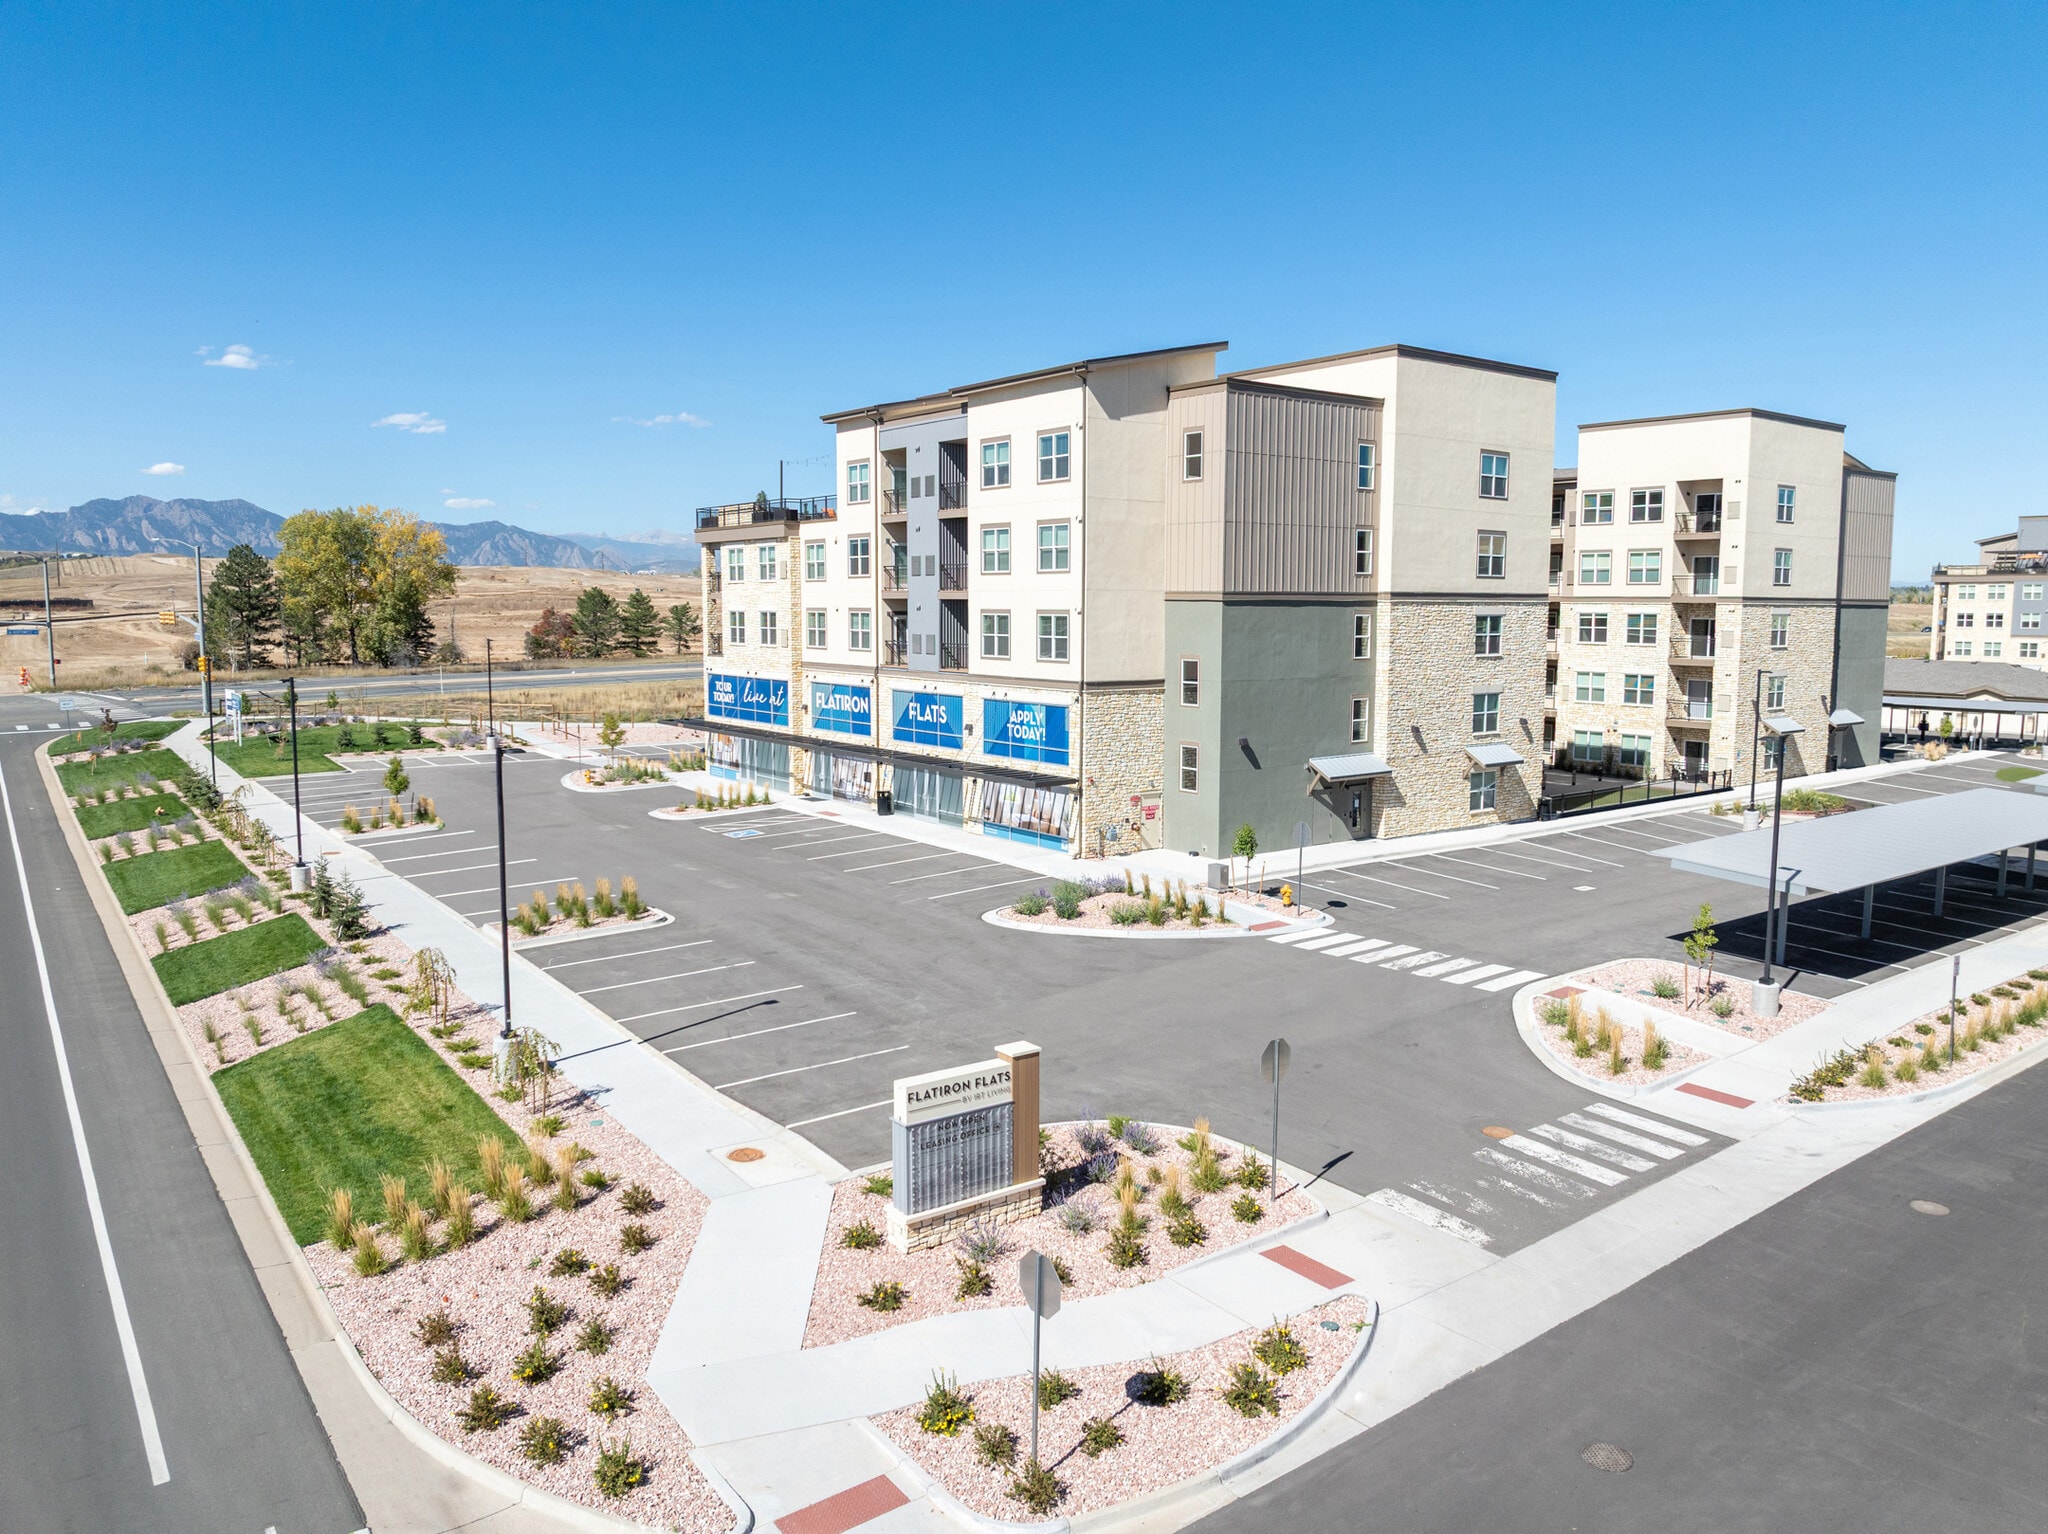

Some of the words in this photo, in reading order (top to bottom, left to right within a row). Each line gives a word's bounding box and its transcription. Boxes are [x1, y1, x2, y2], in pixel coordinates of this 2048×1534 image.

[715, 681, 732, 692] TOUR
[743, 681, 767, 703] live
[769, 685, 785, 707] at
[713, 691, 734, 704] TODAY!
[816, 692, 869, 714] FLATIRON
[908, 702, 947, 724] FLATS
[1010, 710, 1043, 725] APPLY
[1007, 723, 1046, 741] TODAY!
[908, 1080, 971, 1104] FLATIRON
[975, 1071, 1011, 1089] FLATS
[938, 1121, 958, 1131] NOW
[961, 1115, 985, 1126] OPEN
[920, 1134, 958, 1150] LEASING
[960, 1125, 990, 1140] OFFICE
